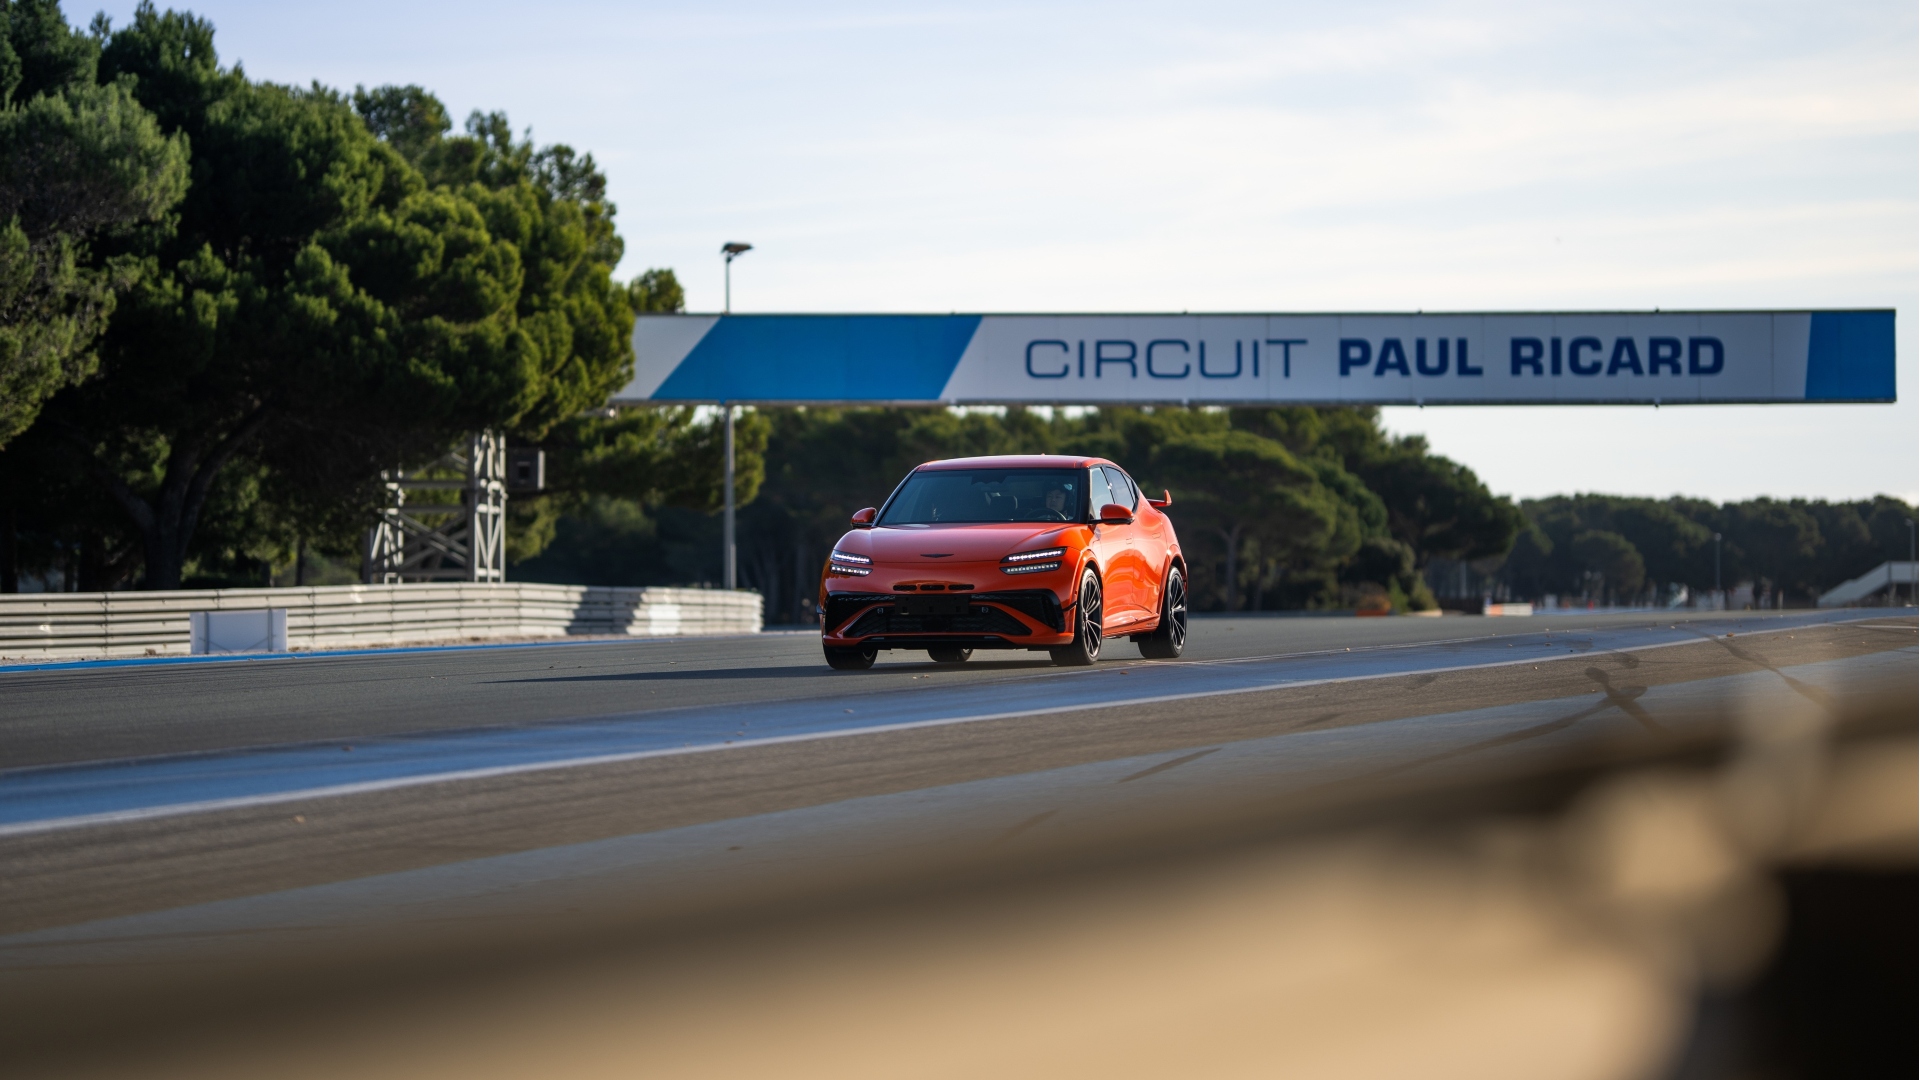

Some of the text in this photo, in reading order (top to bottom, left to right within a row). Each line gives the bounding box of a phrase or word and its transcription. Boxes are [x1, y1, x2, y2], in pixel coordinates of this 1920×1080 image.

[1025, 336, 1725, 379] CIRCUIT PAUL RICARD
